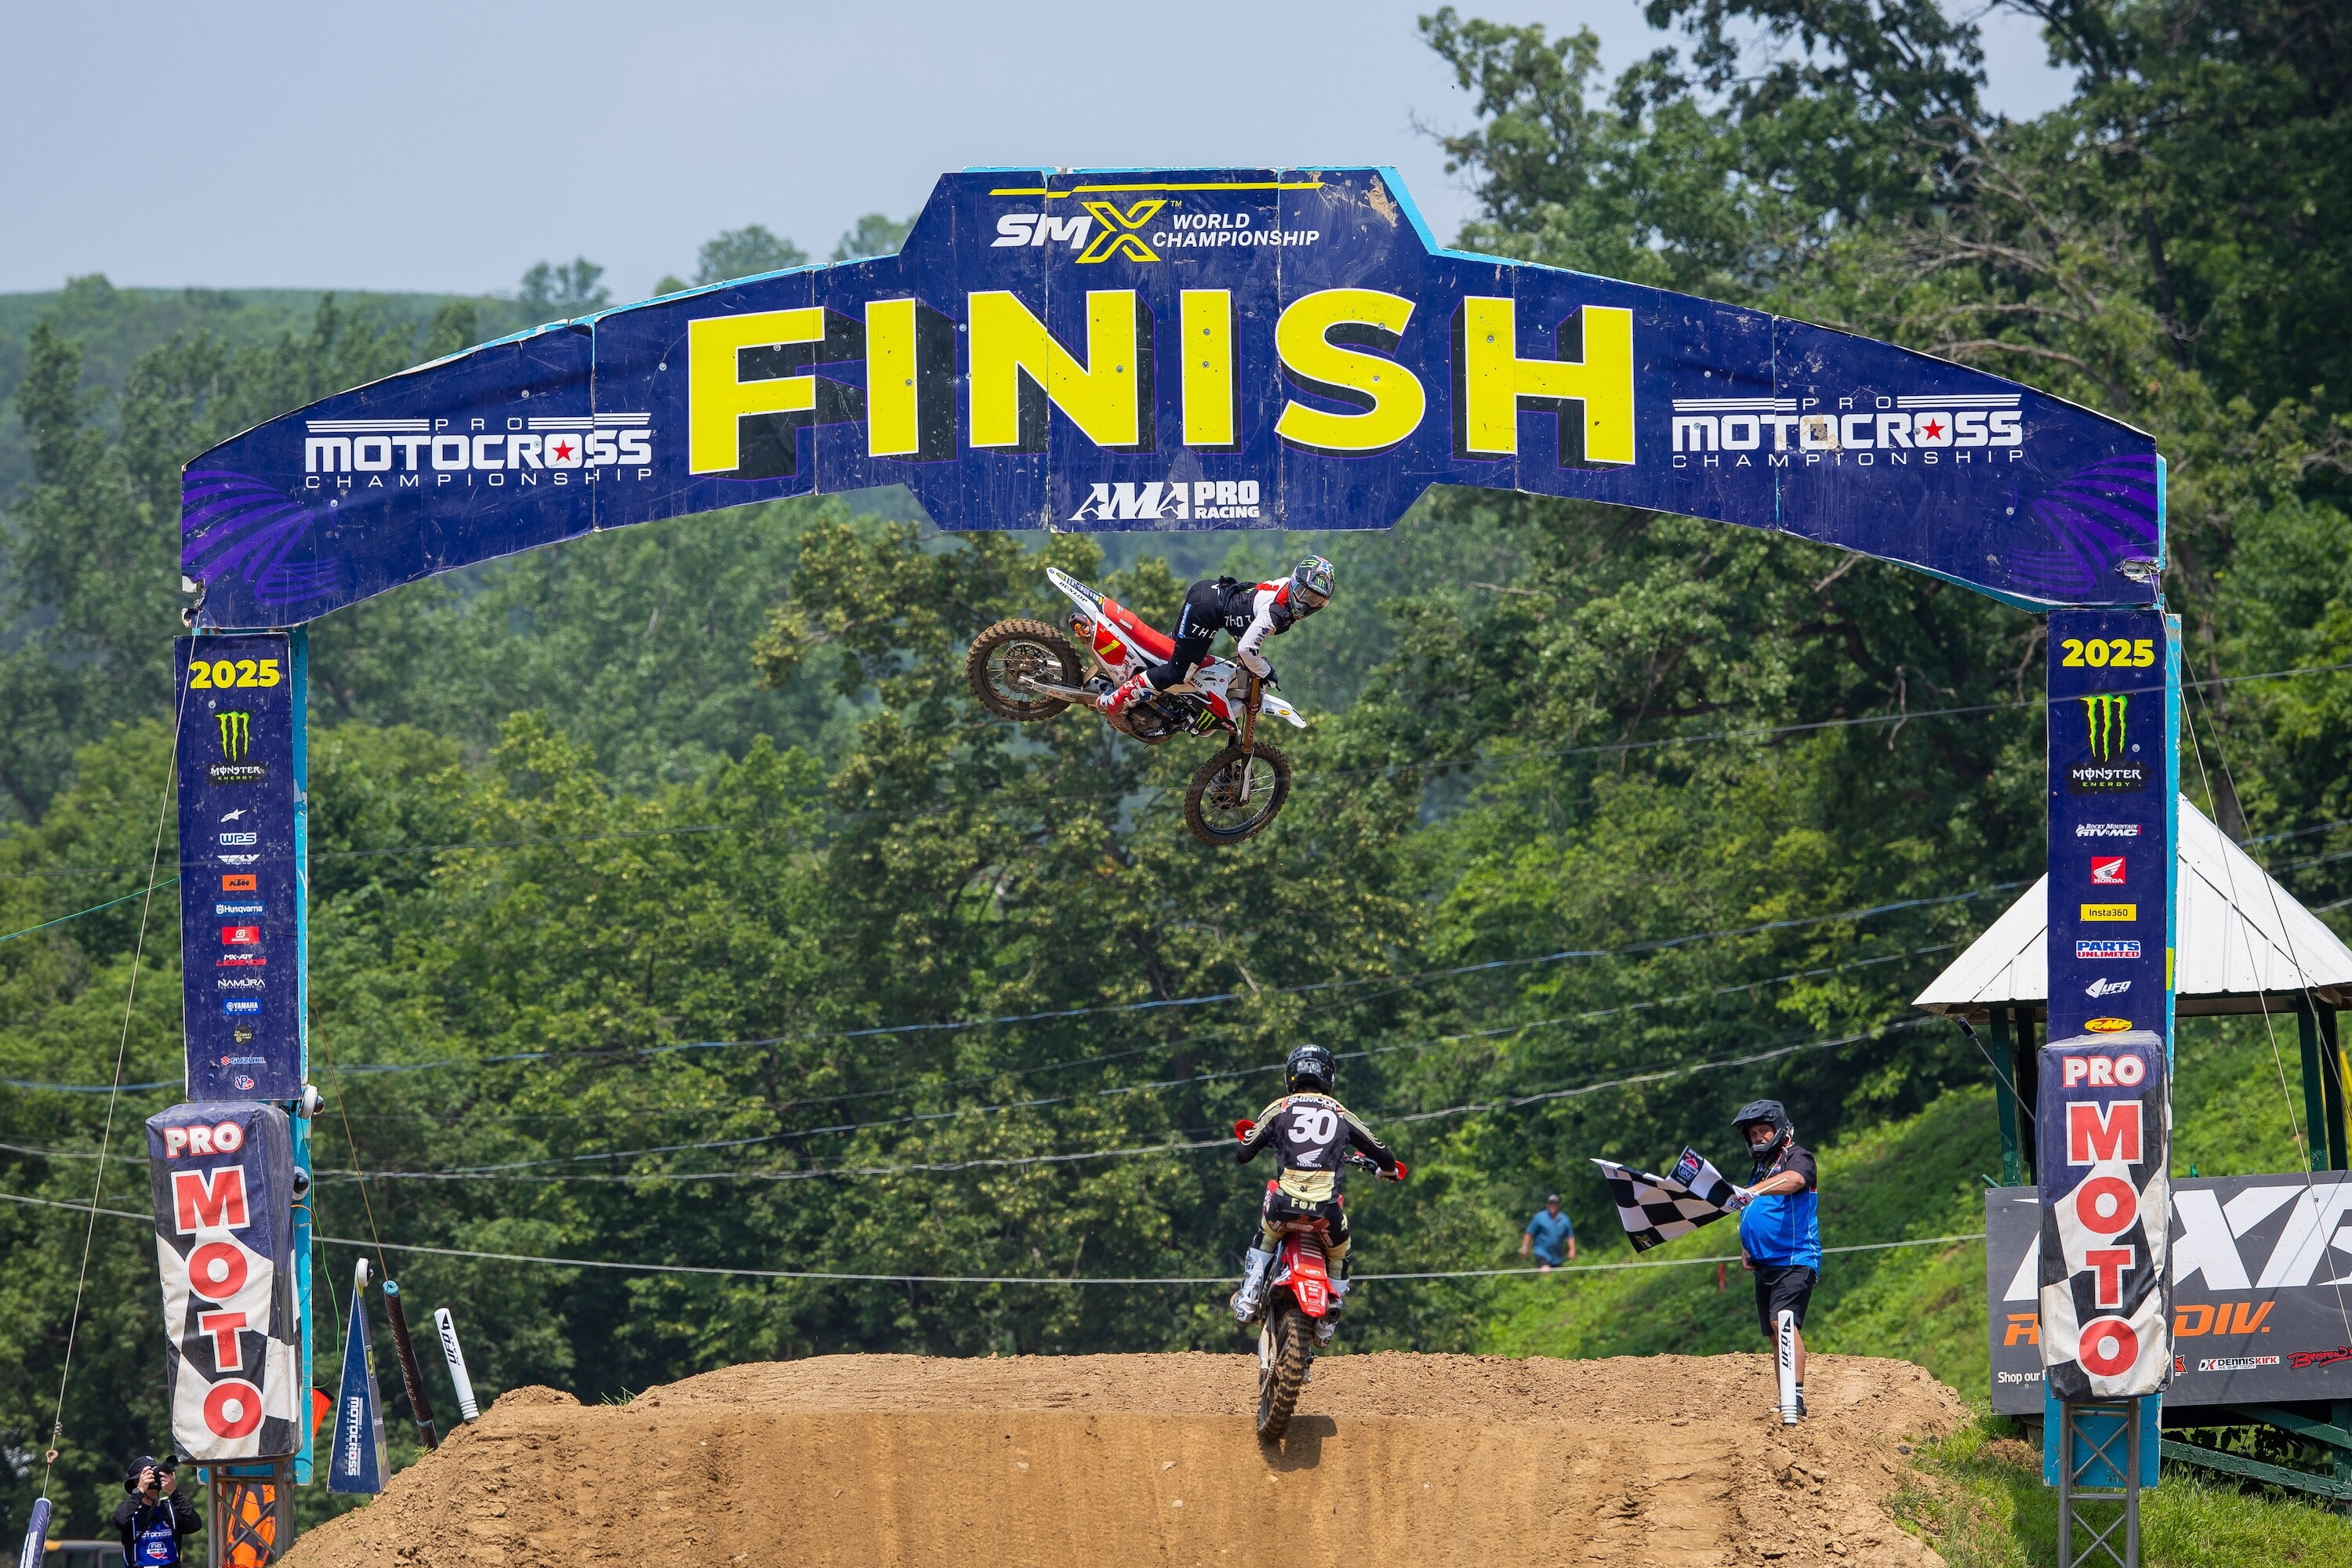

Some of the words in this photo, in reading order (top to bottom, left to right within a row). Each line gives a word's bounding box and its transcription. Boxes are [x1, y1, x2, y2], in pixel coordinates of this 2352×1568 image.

[1172, 212, 1250, 230] WORLD
[990, 199, 1167, 263] SMX
[1152, 230, 1319, 248] CHAMPIONSHIP
[687, 287, 1637, 476] FINISH
[1803, 396, 1892, 409] PRO
[435, 417, 524, 430] PRO
[1672, 410, 2023, 452] MOTOCROSS
[305, 429, 652, 472] MOTOCROSS
[1672, 449, 2024, 468] CHAMPIONSHIP
[305, 467, 652, 489] CHAMPIONSHIP
[1067, 481, 1189, 521] AMA
[1194, 480, 1260, 505] PRO
[1194, 505, 1260, 519] RACING
[1058, 582, 1088, 602] DUNLOP
[1191, 623, 1218, 639] THO
[1098, 640, 1120, 655] 1
[2060, 638, 2155, 667] 2025
[189, 659, 281, 689] 2025
[1190, 677, 1203, 688] MAHA
[210, 765, 261, 775] MONSTER
[2072, 768, 2143, 780] MONSTER
[220, 833, 257, 845] WPS
[229, 878, 250, 887] KTM
[224, 905, 263, 913] Husqvarna
[2077, 942, 2140, 951] PARTS
[218, 978, 266, 987] NAMURA
[2101, 981, 2132, 993] UFO
[2085, 1018, 2132, 1030] FMF
[230, 1056, 266, 1065] SUZUKI
[2063, 1054, 2146, 1088] PRO
[1287, 1095, 1338, 1111] SHIMODA
[1288, 1105, 1338, 1145] 30
[163, 1120, 244, 1159] PRO
[1290, 1197, 1318, 1211] FOX
[2066, 1099, 2143, 1378] MOTO
[170, 1163, 264, 1442] MOTO
[2173, 1301, 2276, 1338] DIV.
[441, 1332, 457, 1365] UFO
[1780, 1334, 1789, 1369] UFO
[1998, 1371, 2023, 1385] Shop
[2024, 1372, 2041, 1381] our
[348, 1396, 360, 1476] MOTOCROSS
